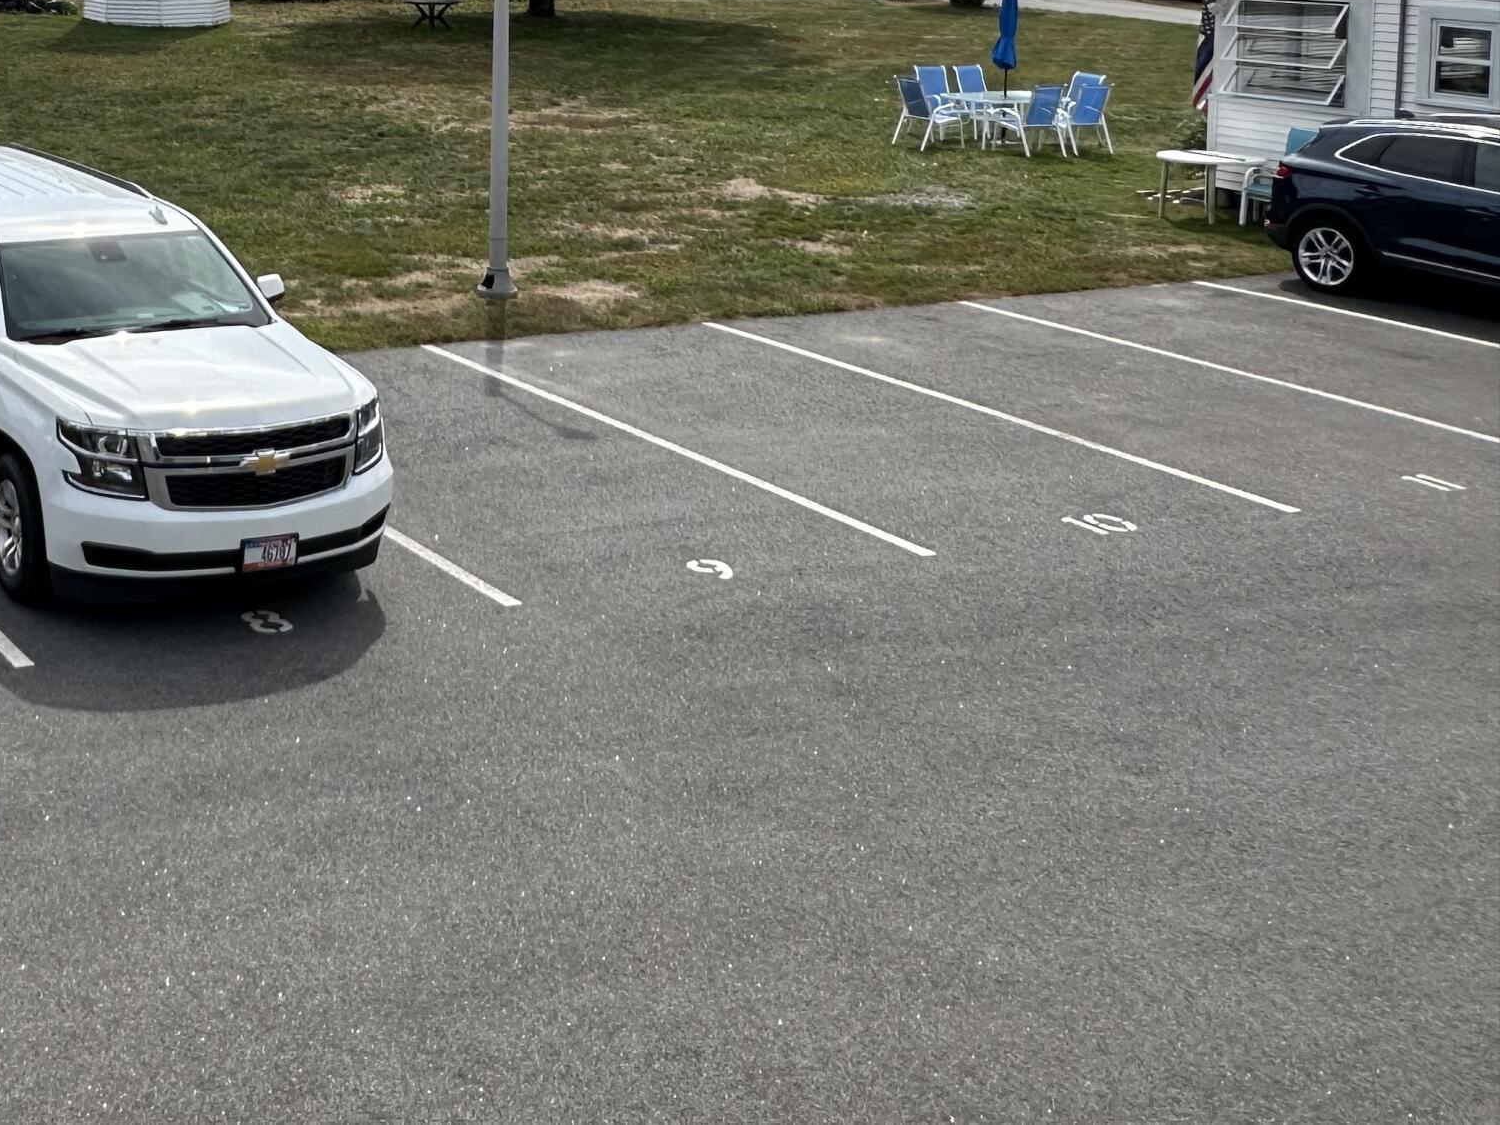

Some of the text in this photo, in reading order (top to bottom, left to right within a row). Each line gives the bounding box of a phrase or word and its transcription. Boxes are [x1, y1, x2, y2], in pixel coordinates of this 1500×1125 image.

[1060, 513, 1138, 535] 10
[686, 559, 734, 580] 9
[241, 610, 294, 633] 8
